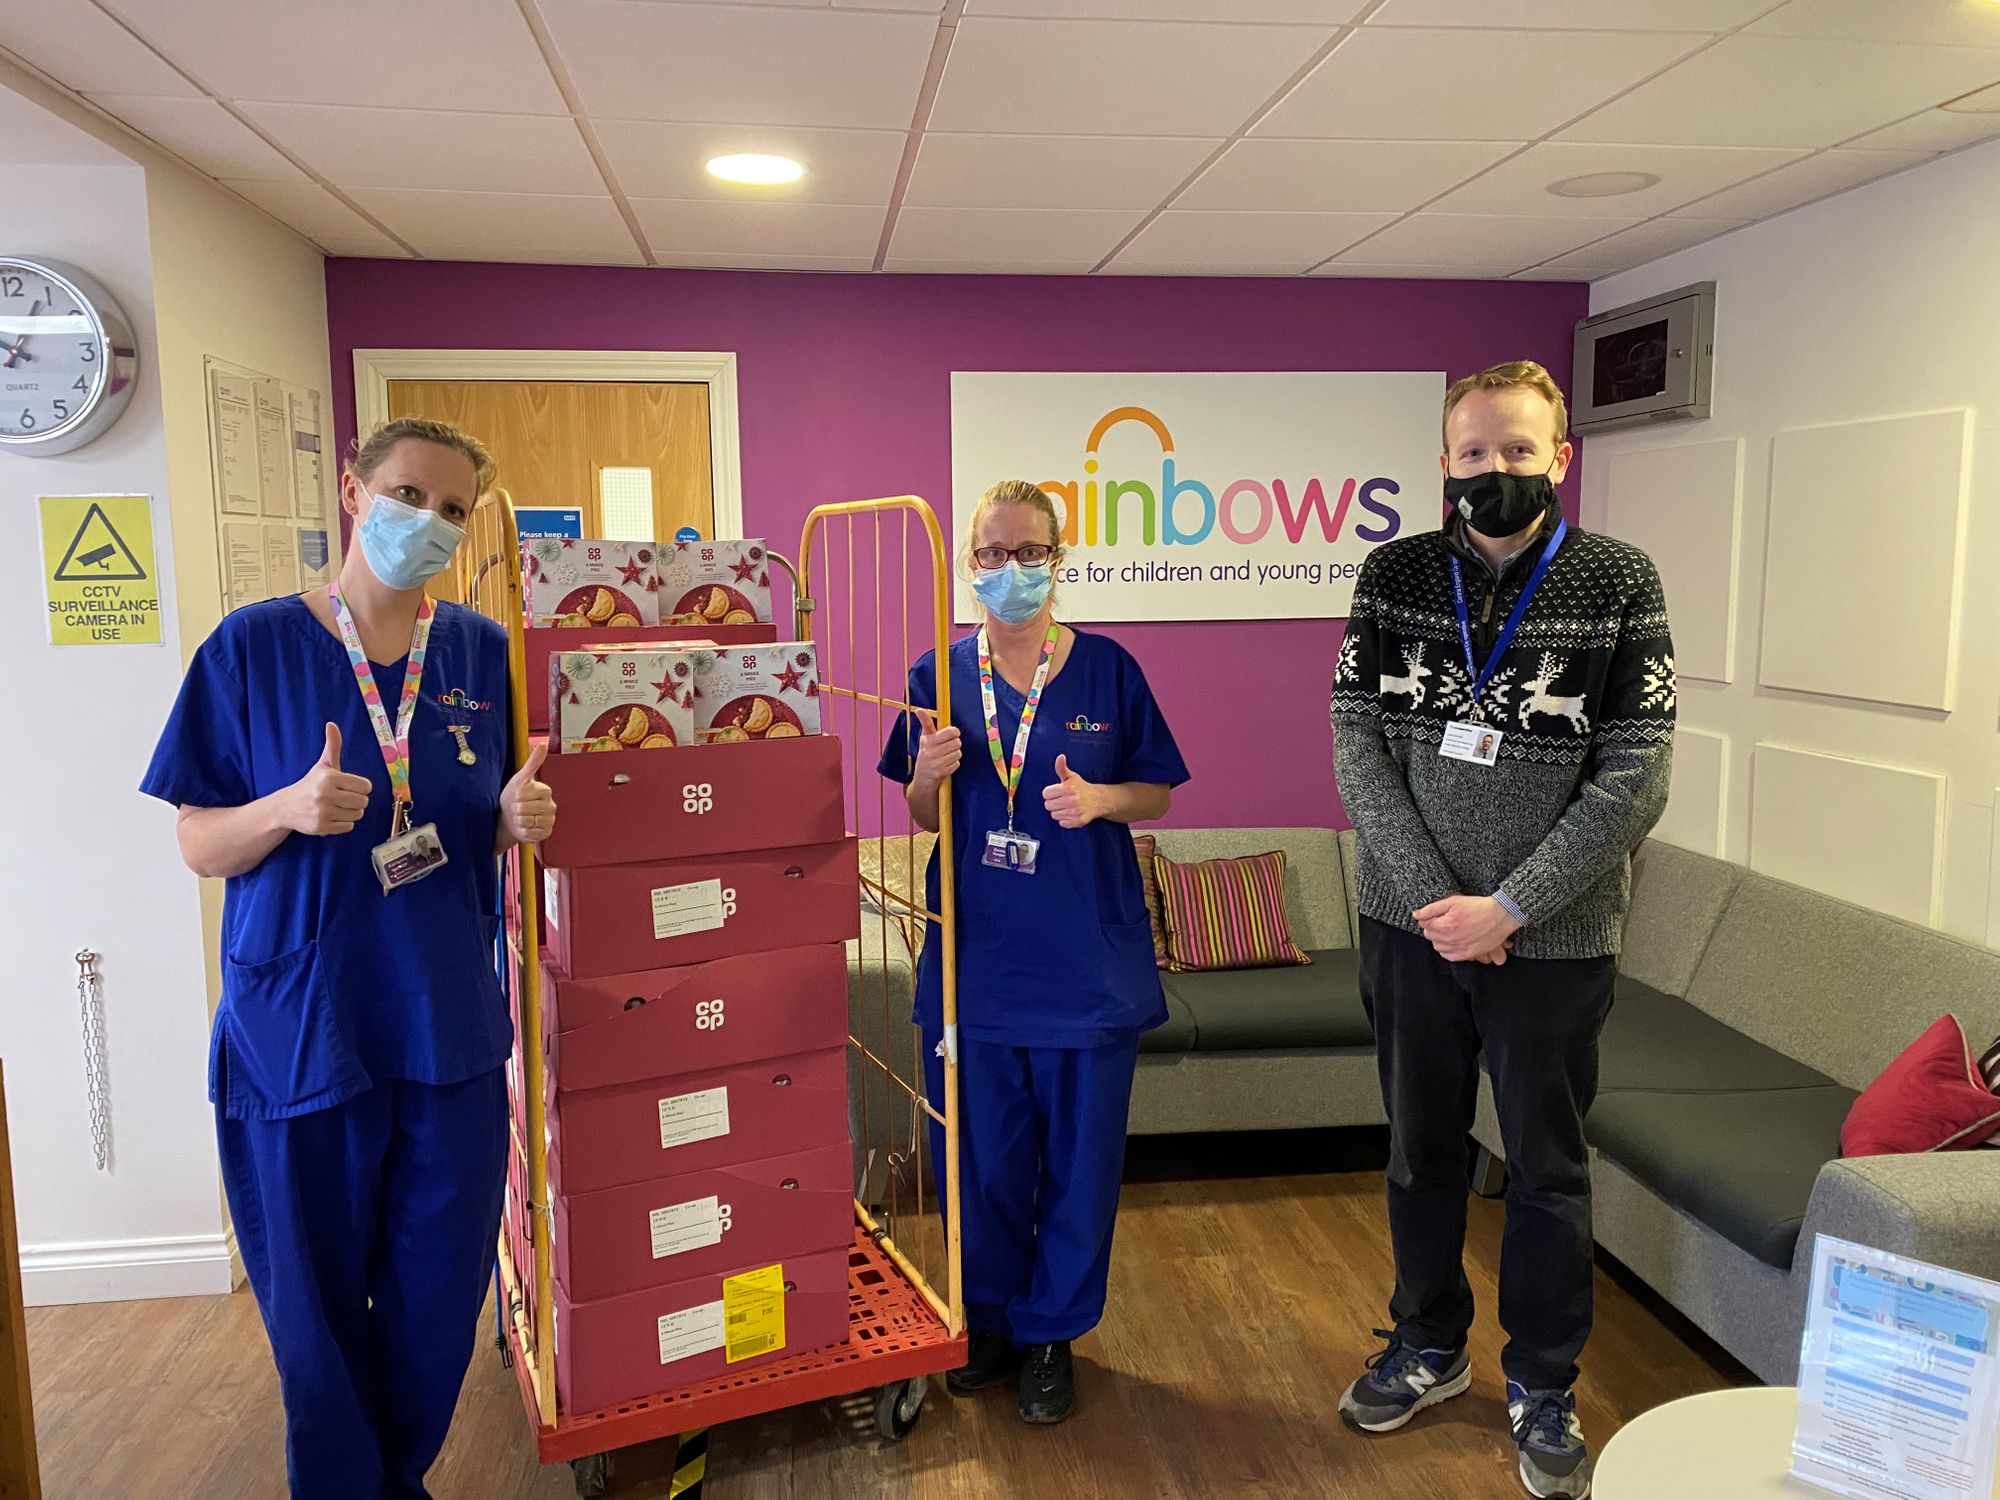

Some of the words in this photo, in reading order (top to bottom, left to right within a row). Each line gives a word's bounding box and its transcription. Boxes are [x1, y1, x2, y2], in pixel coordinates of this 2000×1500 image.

[2, 276, 25, 298] 12
[45, 286, 52, 307] 1
[79, 342, 95, 362] 3
[5, 383, 39, 391] QUARTZ
[72, 374, 89, 394] 4
[20, 408, 35, 429] 6
[53, 399, 69, 420] 5
[1036, 458, 1402, 547] ainbows
[544, 531, 562, 539] keep
[1086, 562, 1114, 583] for
[1120, 560, 1203, 583] children
[1210, 560, 1251, 582] and
[1257, 562, 1322, 585] young
[82, 586, 121, 598] CCTV
[48, 599, 158, 613] SURVEILLANCE
[64, 613, 128, 626] CAMERA
[130, 613, 145, 626] IN
[91, 628, 121, 641] USE
